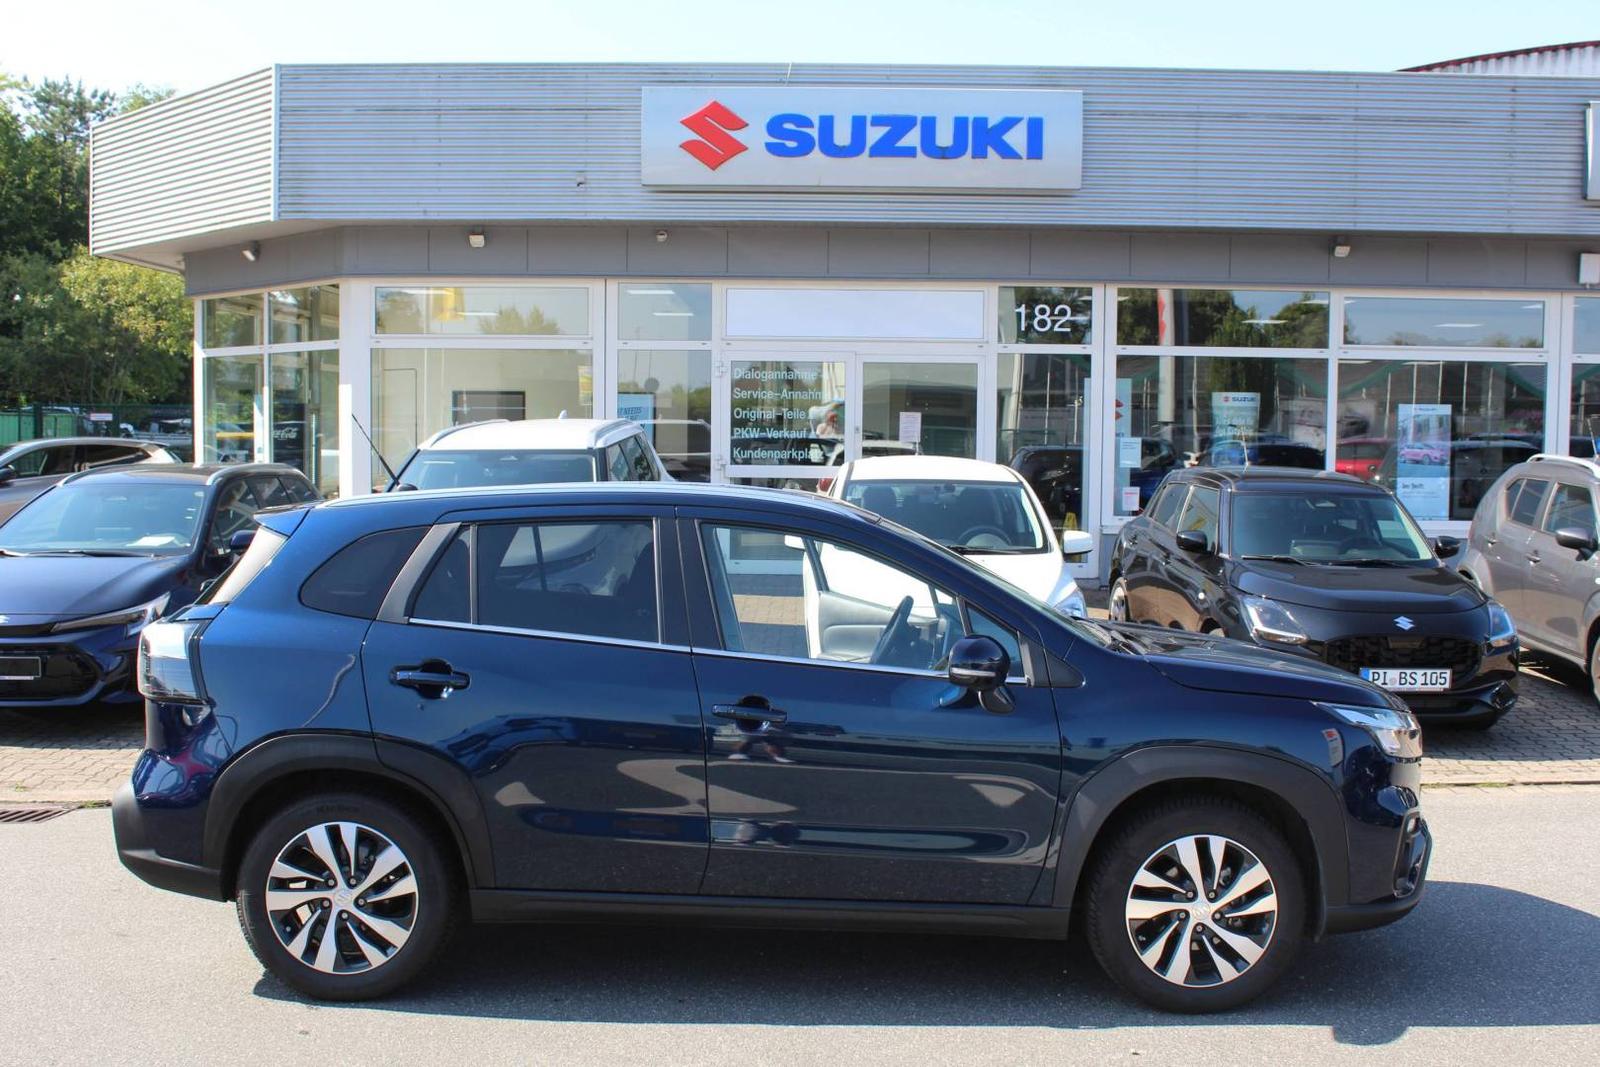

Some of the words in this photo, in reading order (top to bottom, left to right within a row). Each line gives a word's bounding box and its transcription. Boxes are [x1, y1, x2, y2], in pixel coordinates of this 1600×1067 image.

[764, 113, 1043, 160] SUZUKI
[1015, 303, 1072, 332] 182
[733, 407, 807, 421] Original-Teile
[733, 427, 808, 439] PKW-Verkauf
[1371, 671, 1388, 686] PI
[1399, 671, 1418, 686] BS
[1421, 671, 1447, 686] 105
